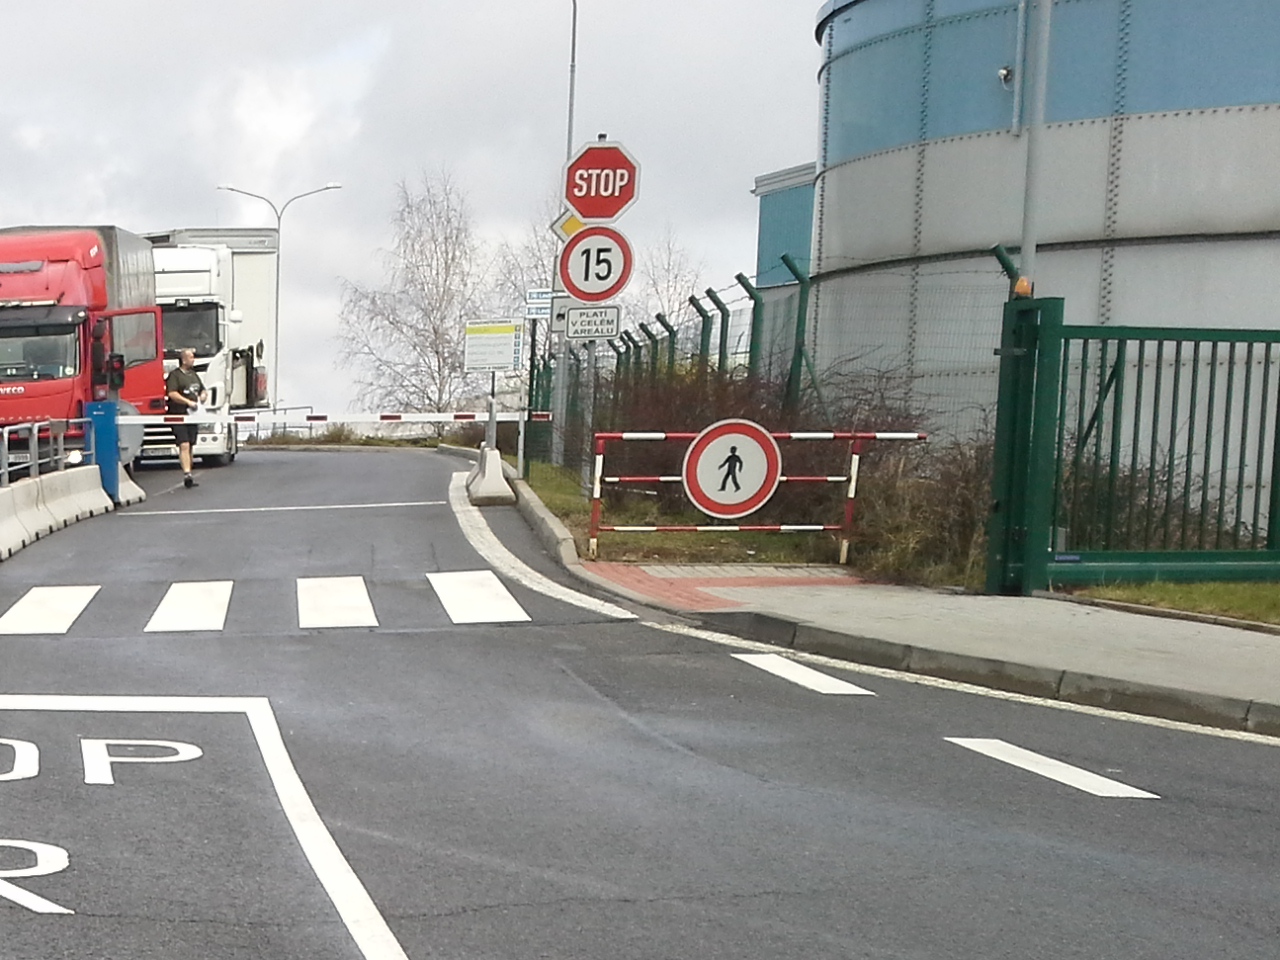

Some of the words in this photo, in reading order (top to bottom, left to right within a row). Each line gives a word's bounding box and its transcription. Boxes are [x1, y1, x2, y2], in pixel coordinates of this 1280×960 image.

[573, 168, 629, 197] STOP
[580, 247, 613, 282] 15
[579, 309, 608, 318] PLATÍ
[572, 327, 614, 335] AREÁLU
